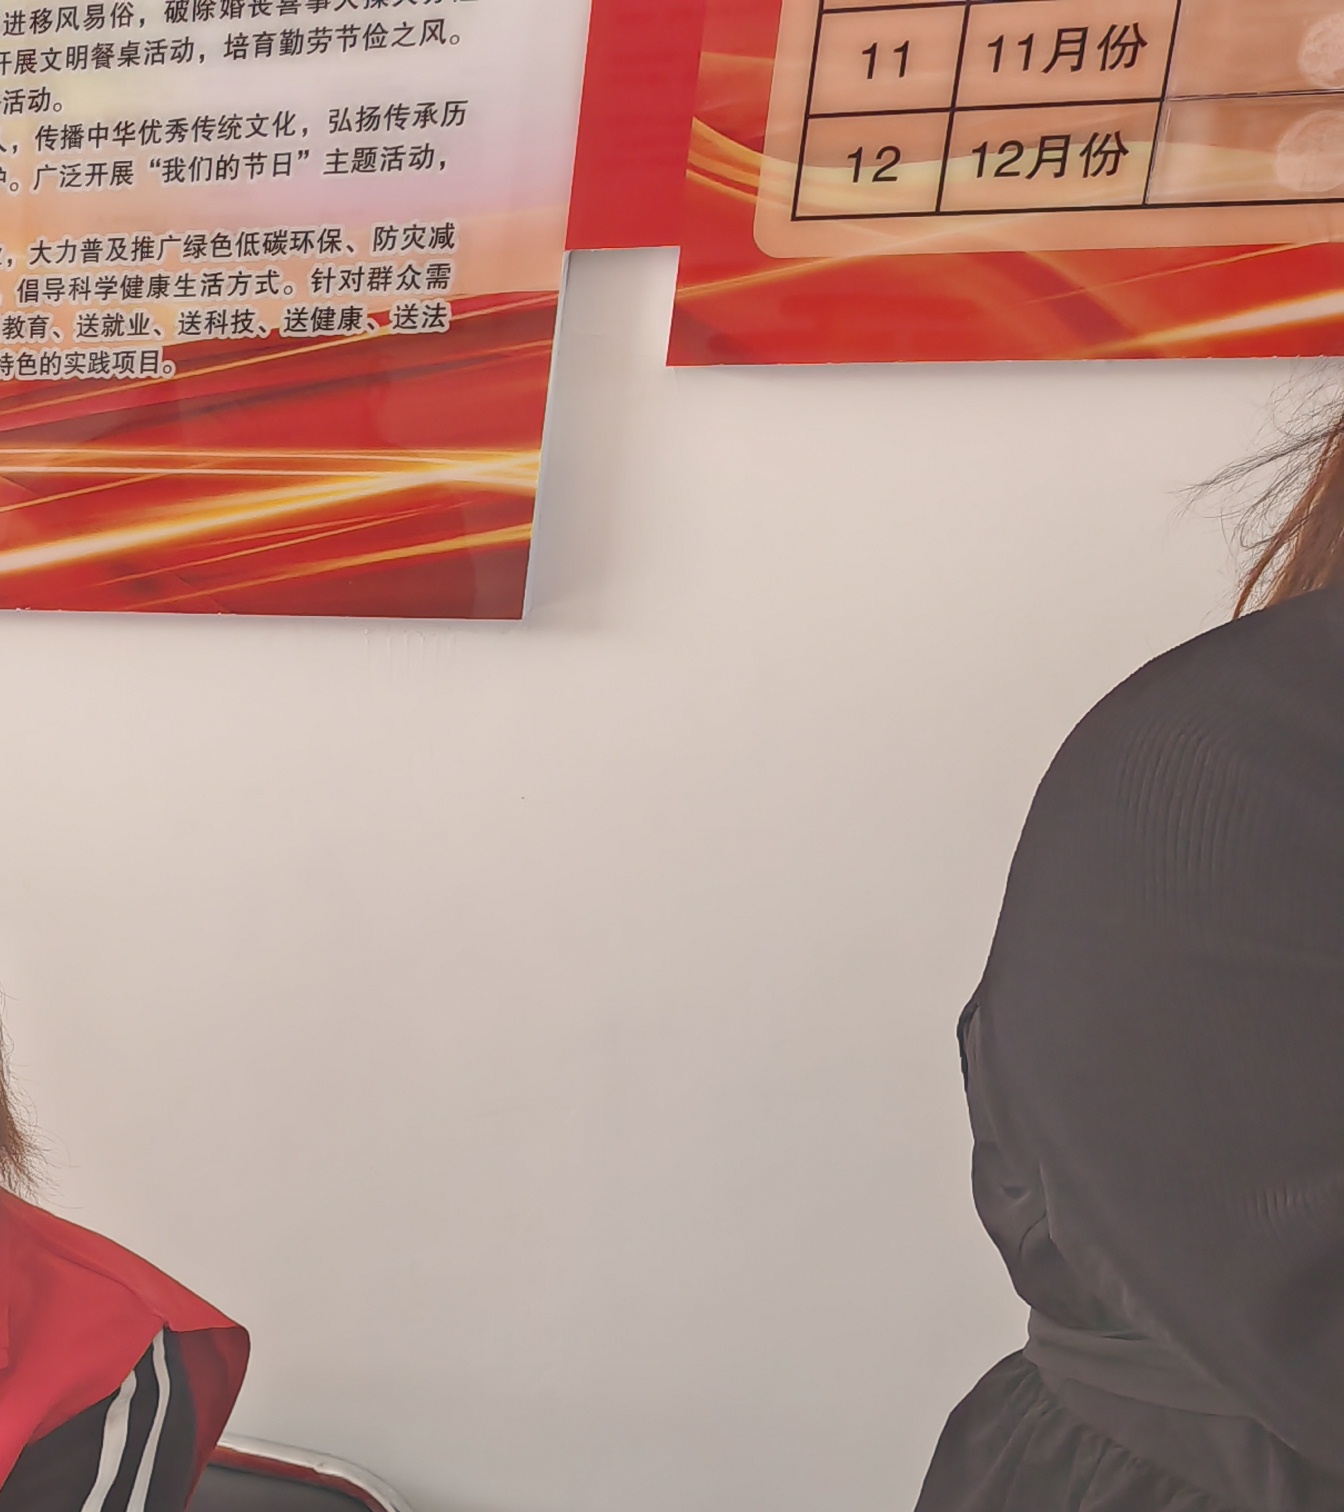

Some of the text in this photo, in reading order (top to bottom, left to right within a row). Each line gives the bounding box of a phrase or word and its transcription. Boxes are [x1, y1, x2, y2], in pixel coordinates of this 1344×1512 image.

[862, 40, 910, 79] 11
[986, 22, 1148, 75] 11月份
[846, 145, 900, 183] 12
[970, 130, 1129, 181] 12月份
